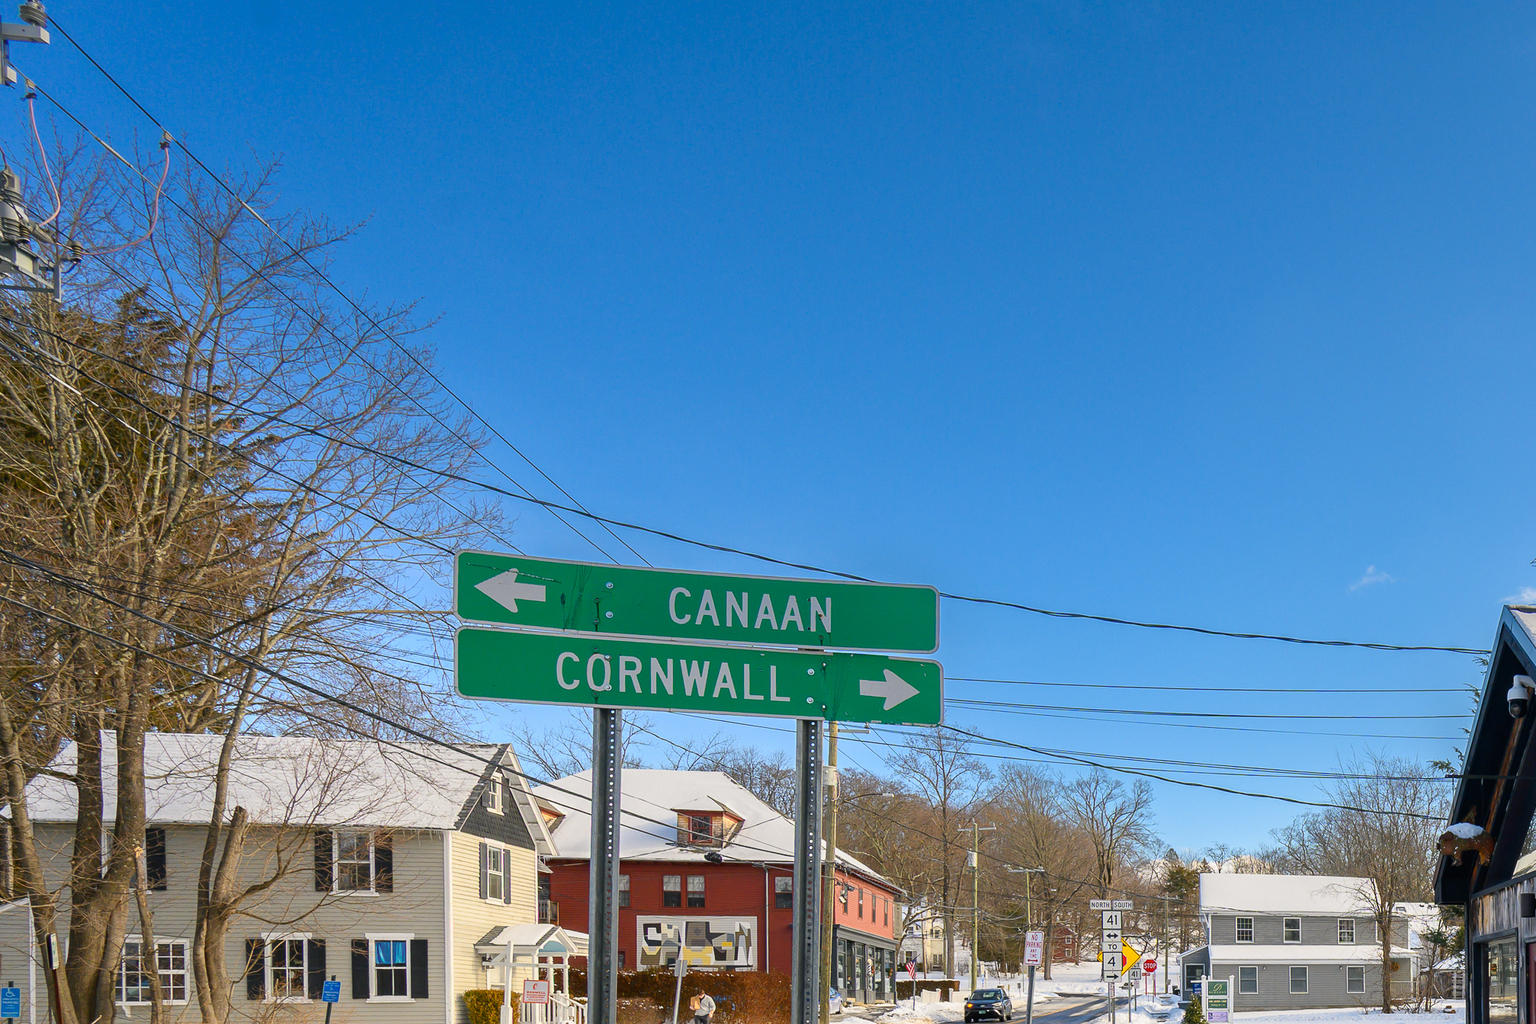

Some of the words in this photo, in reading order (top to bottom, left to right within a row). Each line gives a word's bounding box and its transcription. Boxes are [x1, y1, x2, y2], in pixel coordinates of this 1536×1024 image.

[669, 586, 832, 633] CANAAN
[556, 651, 791, 702] CORNWALL
[1106, 914, 1118, 925] 41
[1107, 956, 1116, 967] 4
